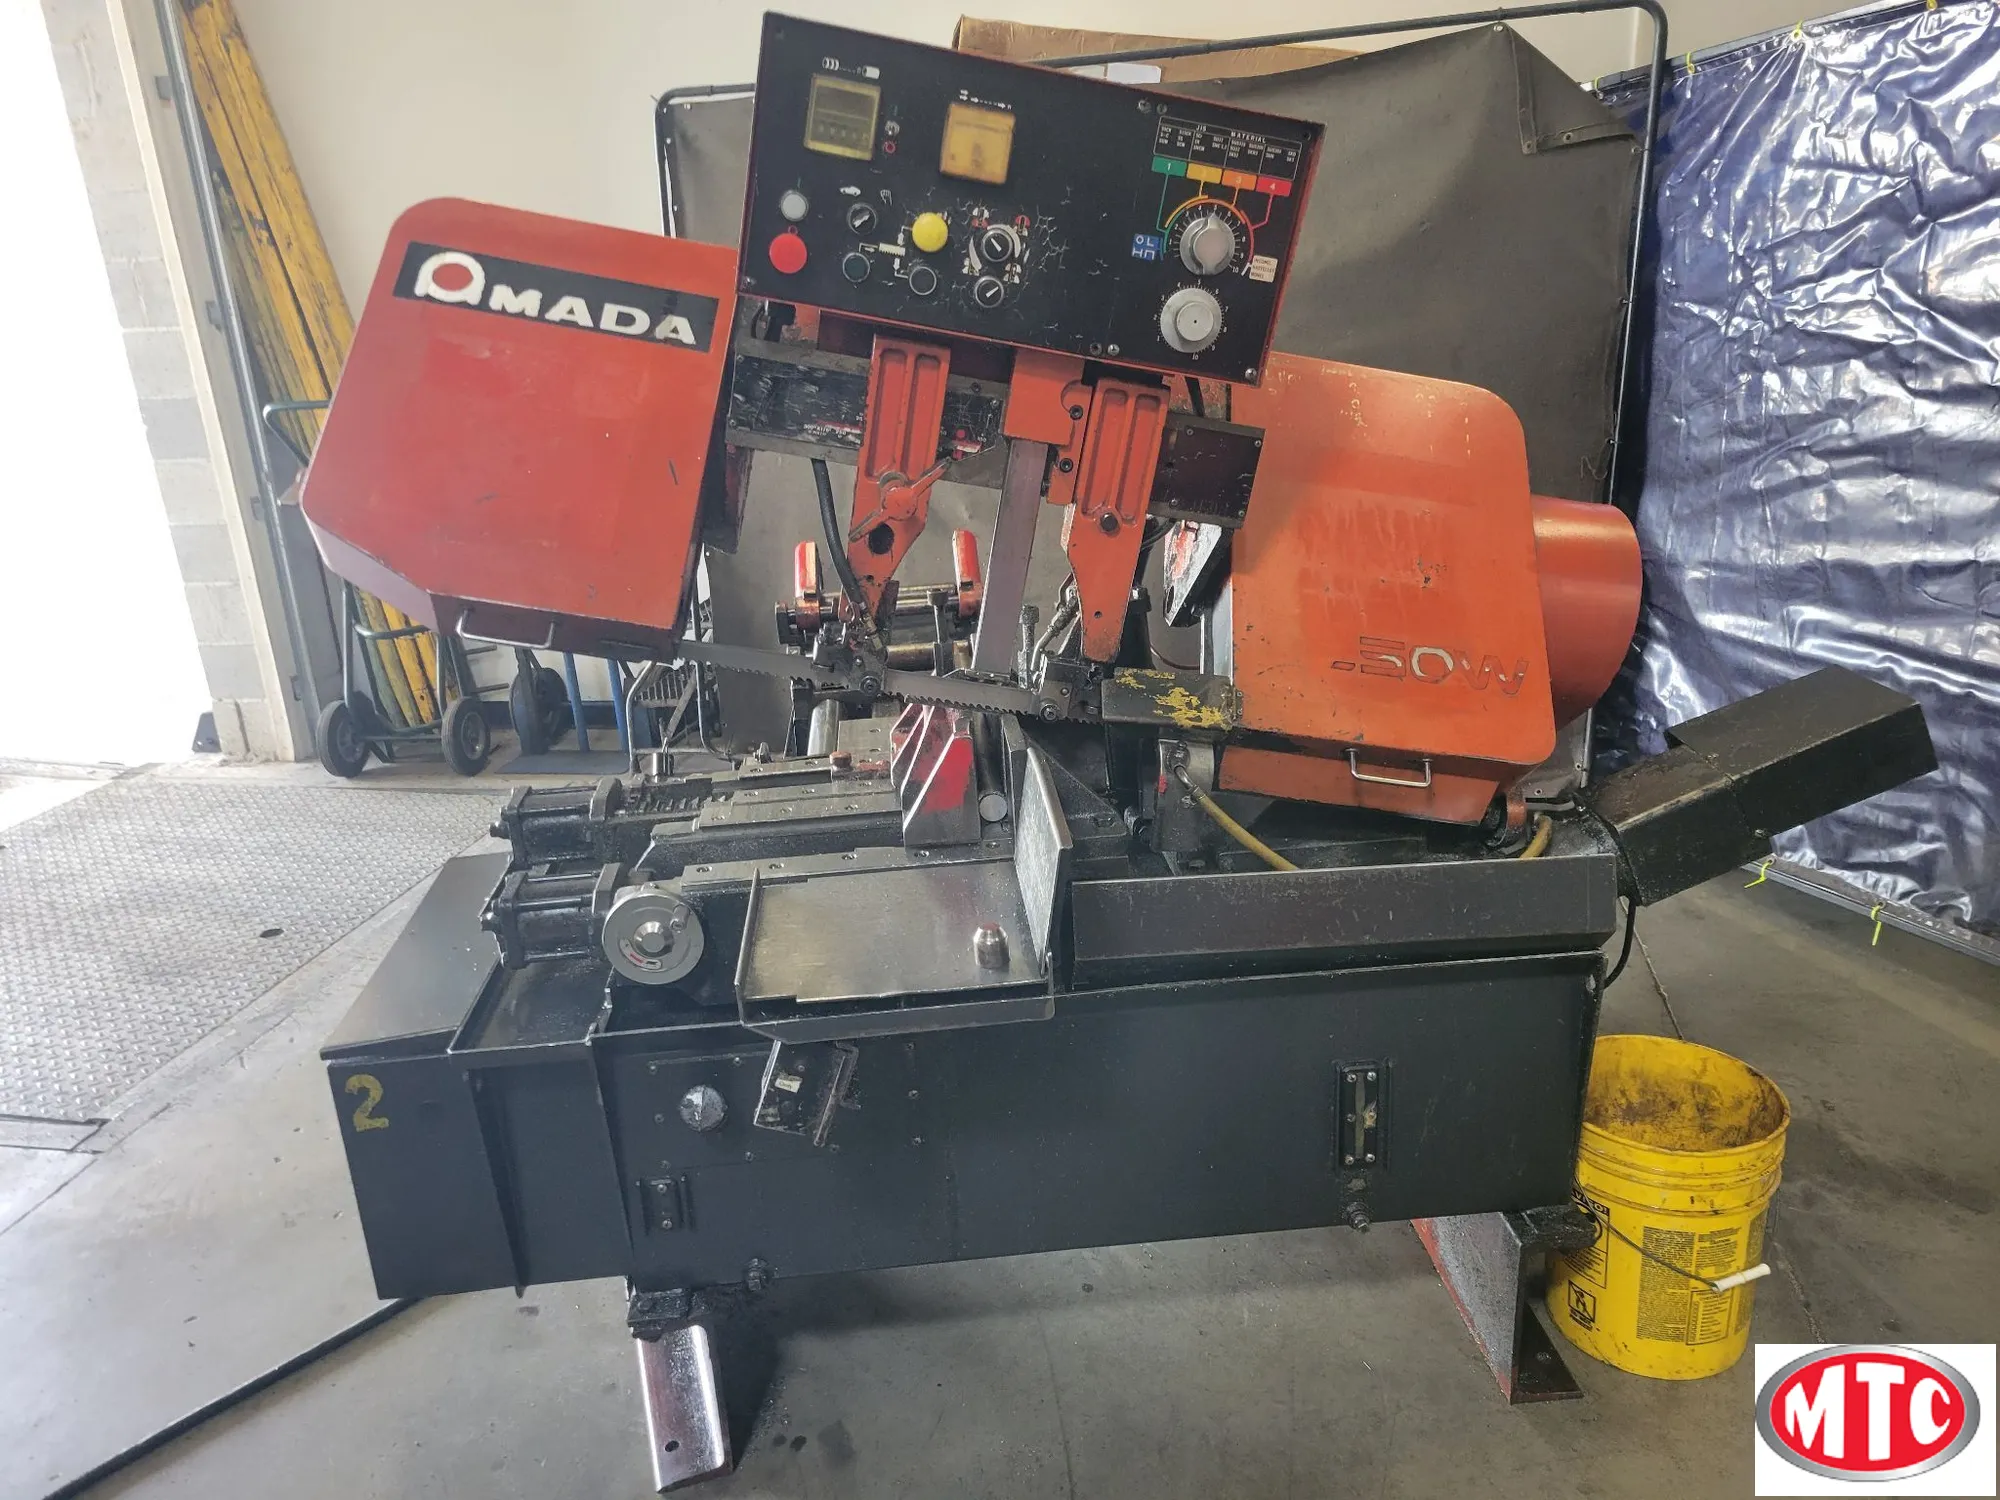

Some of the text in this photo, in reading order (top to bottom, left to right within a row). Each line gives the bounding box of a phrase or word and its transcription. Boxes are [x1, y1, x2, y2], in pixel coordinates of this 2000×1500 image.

[1231, 131, 1266, 144] MATERIAL
[1269, 182, 1276, 190] 4
[345, 1073, 390, 1132] 2
